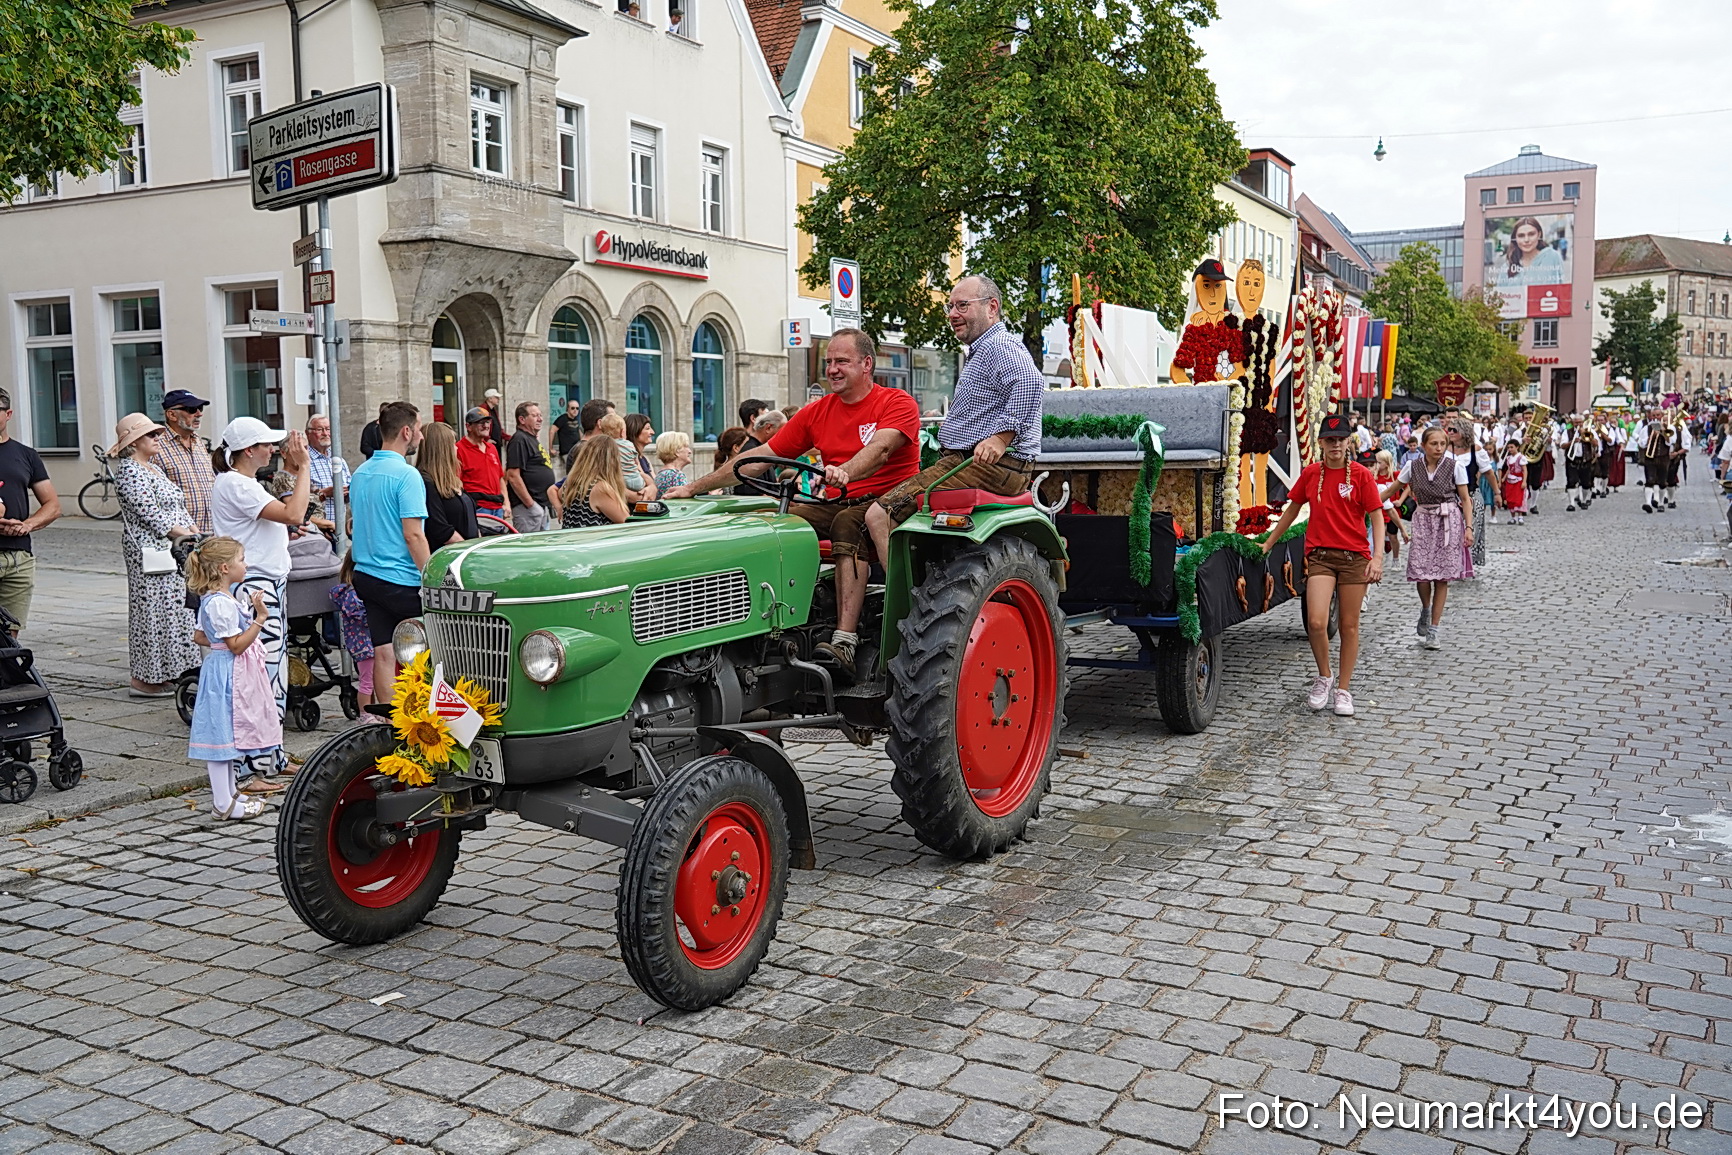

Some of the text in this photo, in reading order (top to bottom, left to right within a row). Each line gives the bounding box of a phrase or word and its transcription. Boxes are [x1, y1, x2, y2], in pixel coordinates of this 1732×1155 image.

[268, 108, 356, 149] Parkleitsystem
[299, 151, 358, 179] Rosengasse
[612, 233, 709, 270] HypoVereinsbank
[839, 299, 853, 309] ZONE
[260, 318, 279, 326] Rathaus
[1525, 355, 1560, 365] rkasse
[423, 586, 493, 612] FENDT
[475, 760, 494, 780] 63
